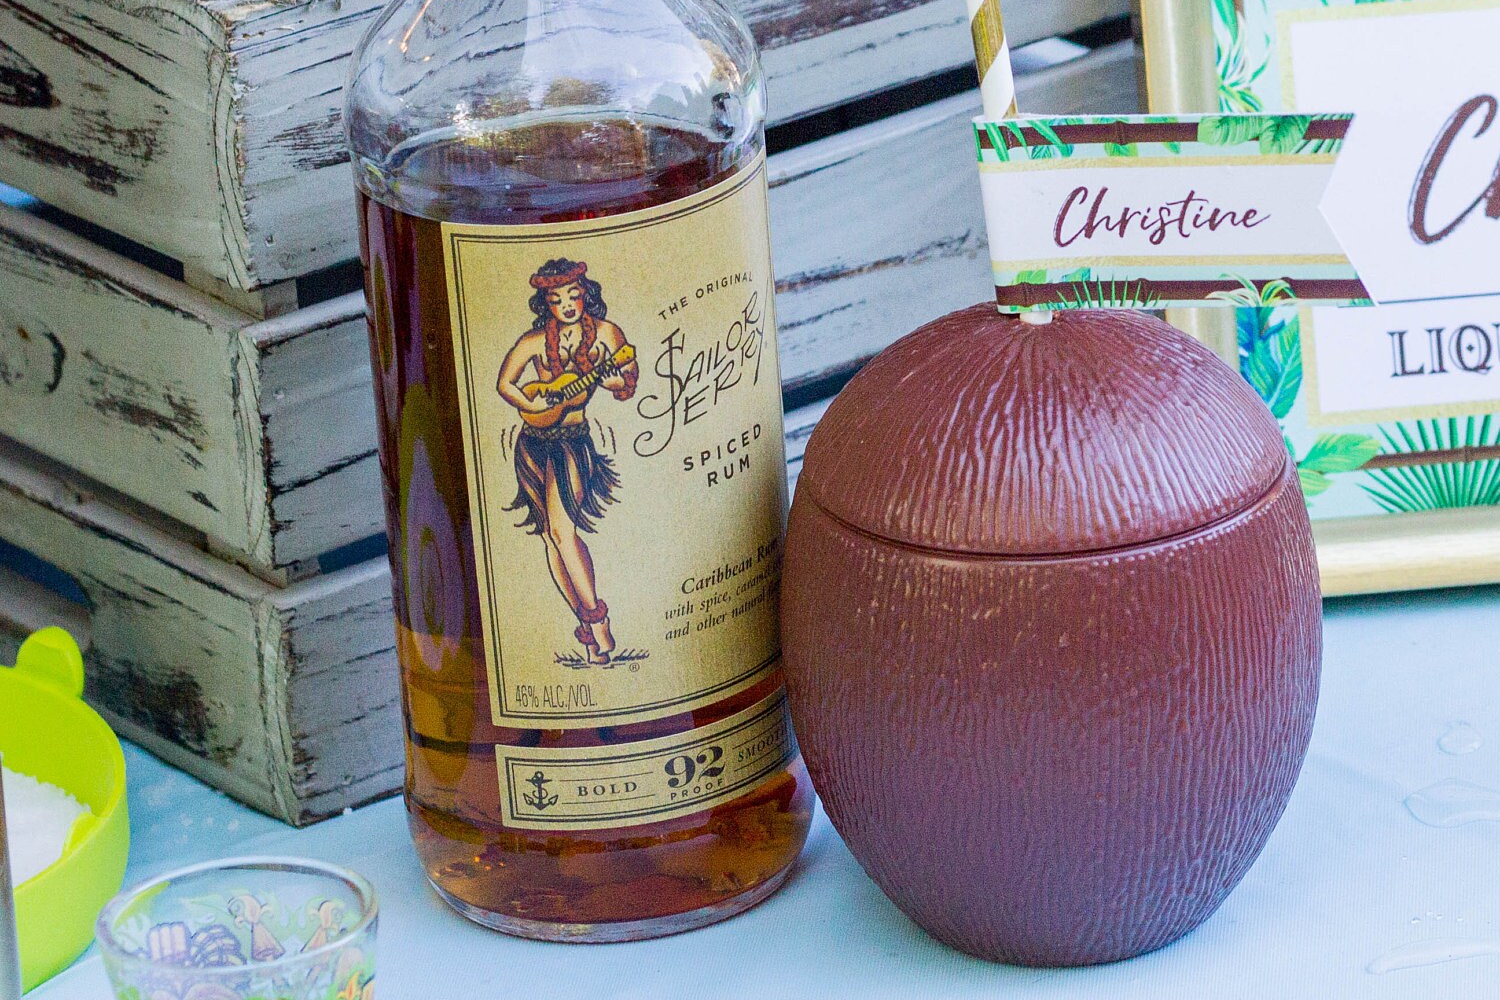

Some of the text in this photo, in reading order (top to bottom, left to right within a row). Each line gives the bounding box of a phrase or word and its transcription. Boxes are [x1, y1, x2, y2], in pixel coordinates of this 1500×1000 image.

[1052, 185, 1271, 248] Christine
[658, 270, 753, 321] THE ORIGINAL
[637, 291, 761, 420] SAILOR
[683, 422, 762, 472] SPICED
[707, 454, 751, 488] RUM
[681, 557, 753, 595] Caribbean
[664, 601, 694, 621] with
[699, 591, 732, 613] spice,
[664, 621, 690, 641] and
[696, 613, 727, 632] other
[731, 584, 766, 619] natural
[515, 684, 540, 709] 46%
[664, 746, 727, 789] 92
[577, 781, 639, 798] BOLD
[670, 778, 724, 800] PROOF
